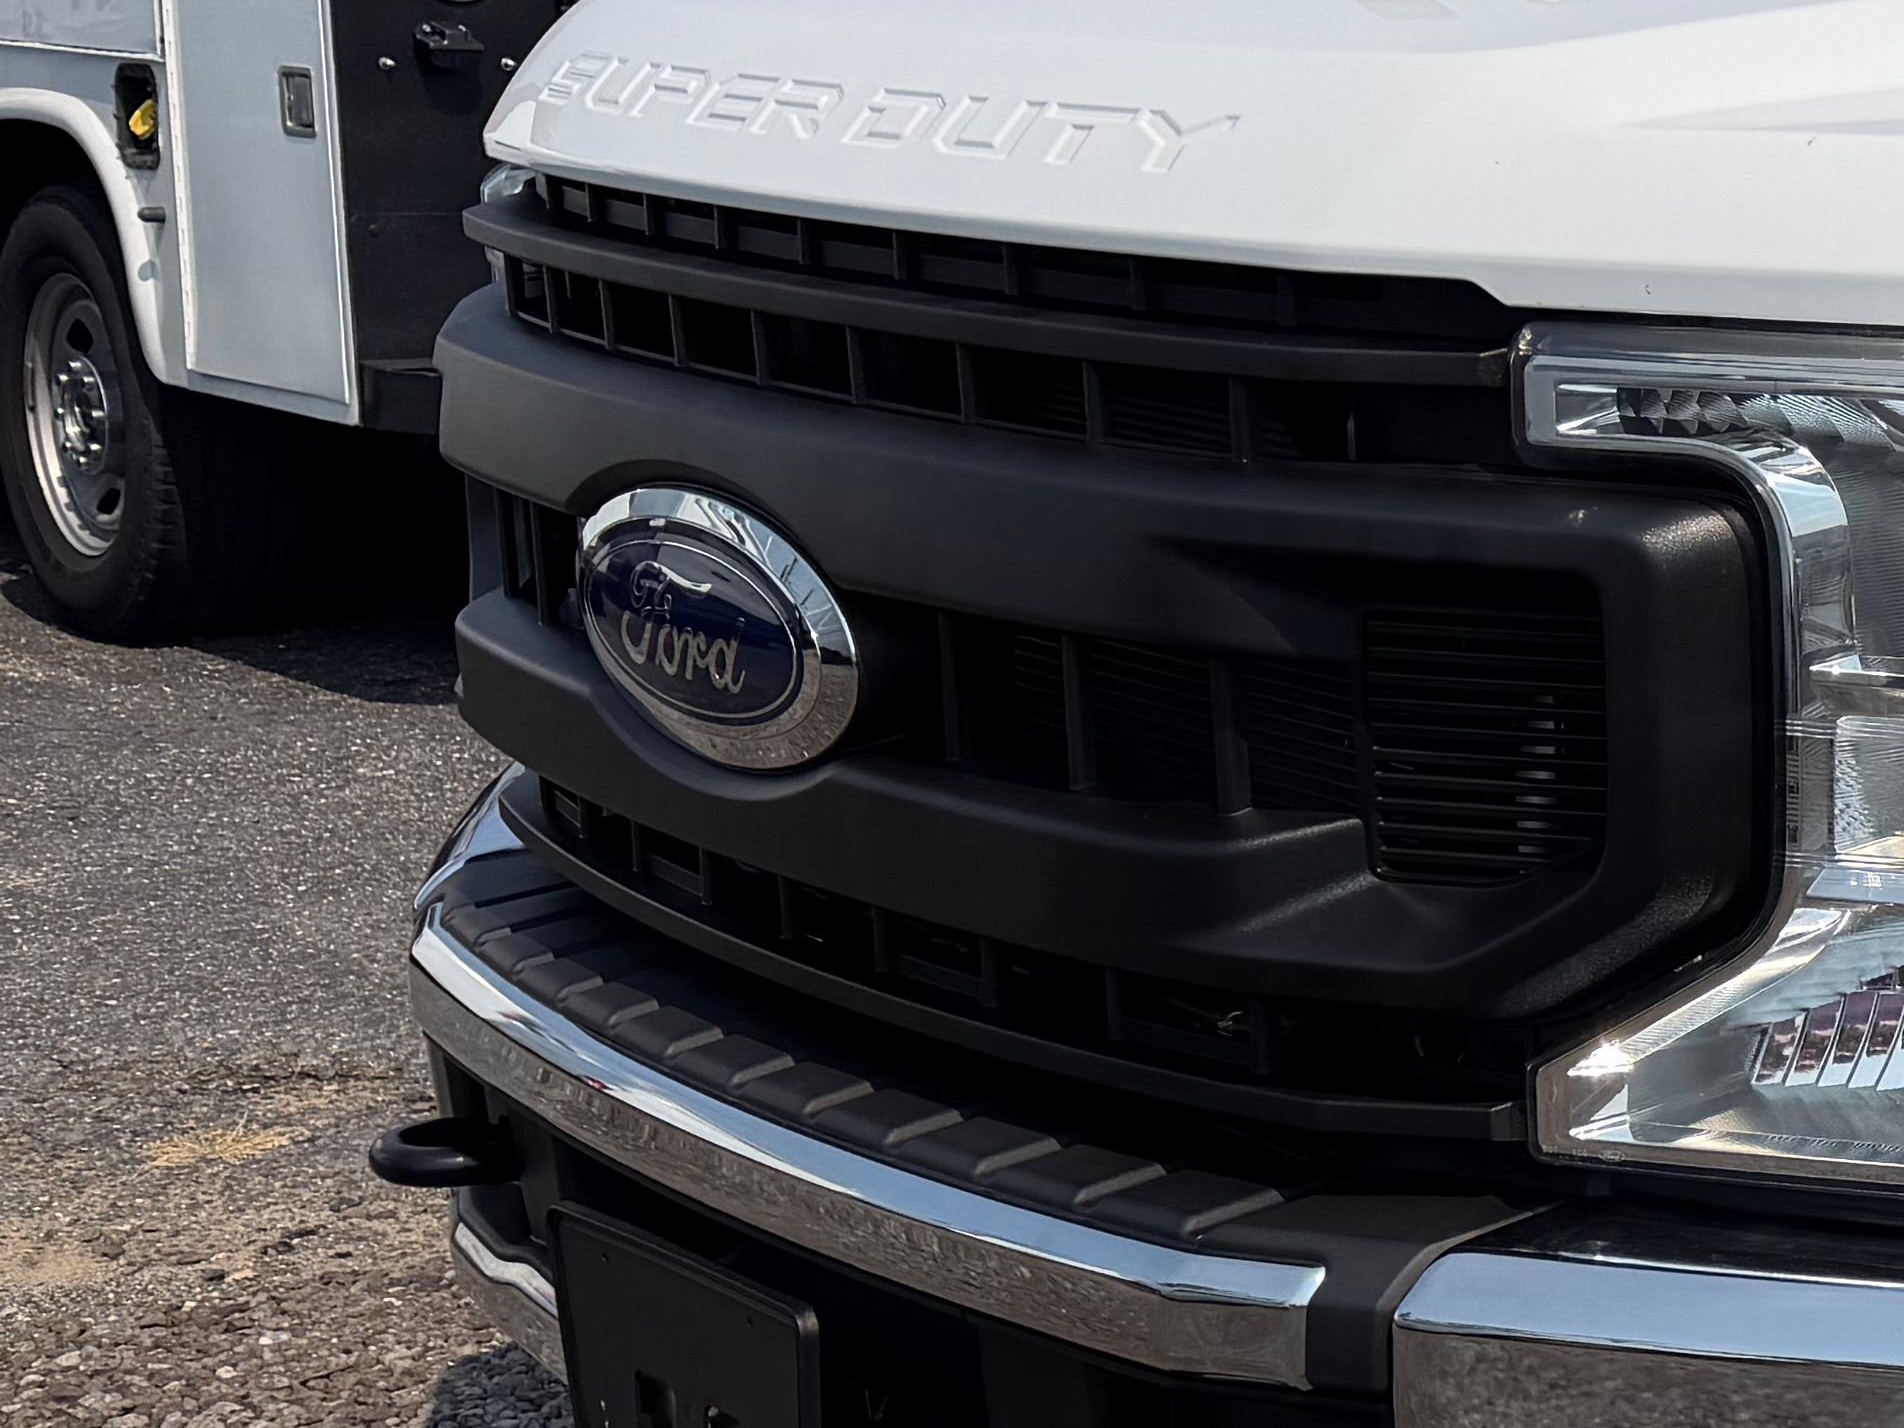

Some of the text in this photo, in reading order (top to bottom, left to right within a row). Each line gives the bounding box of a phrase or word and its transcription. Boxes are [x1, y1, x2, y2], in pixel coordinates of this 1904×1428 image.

[537, 50, 1242, 174] SUPER DUTY
[620, 560, 746, 695] Ford
